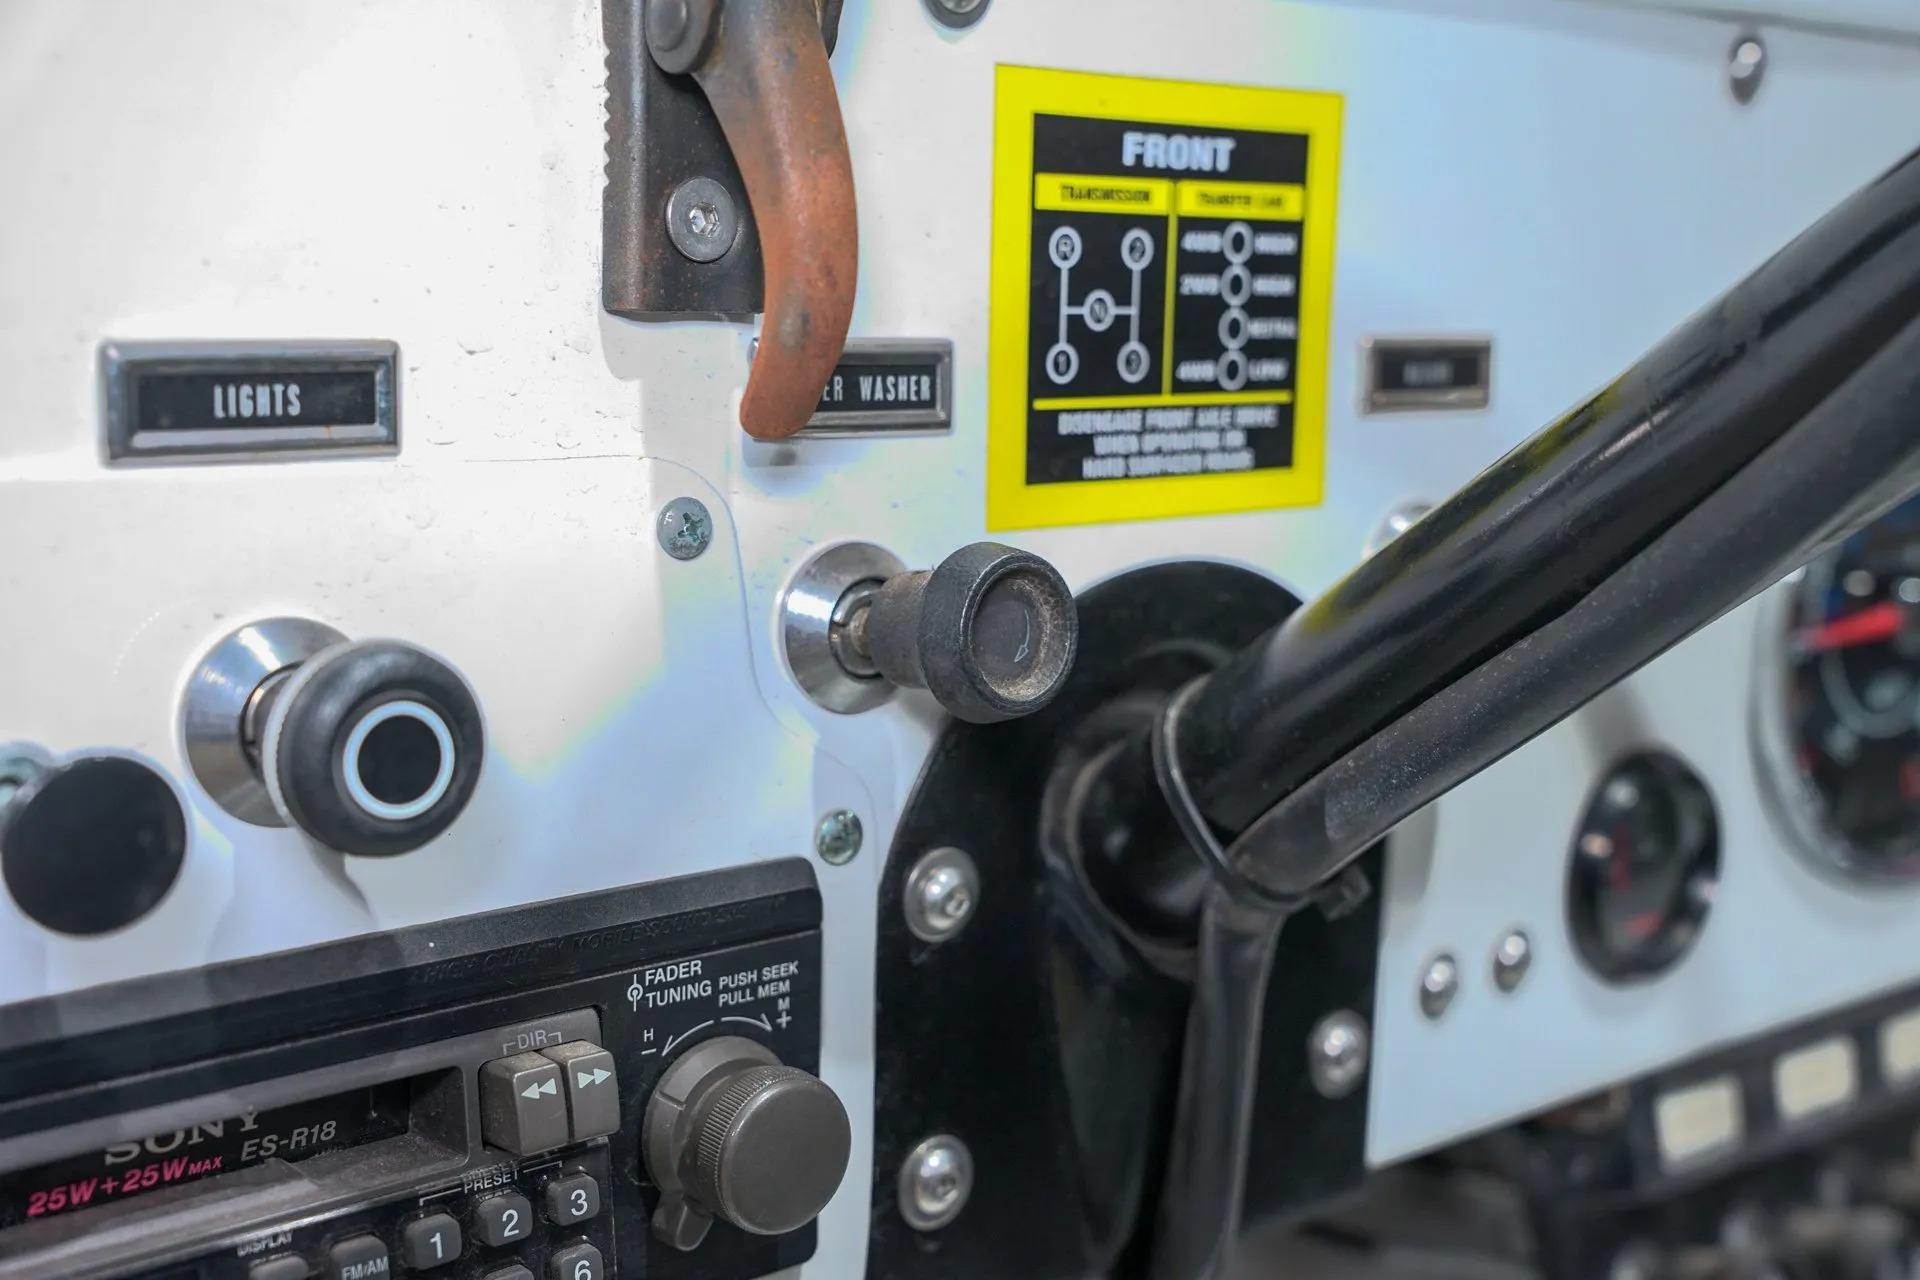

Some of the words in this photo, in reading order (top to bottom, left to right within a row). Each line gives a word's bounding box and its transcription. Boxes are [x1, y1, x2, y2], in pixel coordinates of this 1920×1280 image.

[1121, 131, 1236, 173] FRONT
[213, 383, 302, 419] LIGHTS
[859, 375, 932, 402] WASHER
[645, 960, 702, 986] FADER
[719, 968, 757, 990] PUSH
[761, 960, 799, 981] SEEK
[645, 980, 712, 1008] TUNING
[719, 988, 754, 1008] PULL
[757, 979, 791, 999] MEM
[776, 996, 791, 1012] M
[517, 1030, 547, 1050] DIR
[643, 1028, 654, 1043] H
[103, 1105, 260, 1166] SONY
[241, 1120, 337, 1162] ES-R18
[463, 1170, 519, 1194] PRESET
[570, 1189, 588, 1216] 3
[502, 1210, 520, 1238] 2
[430, 1232, 444, 1259] 1
[341, 1256, 389, 1280] FM/AM
[574, 1260, 592, 1280] 6
